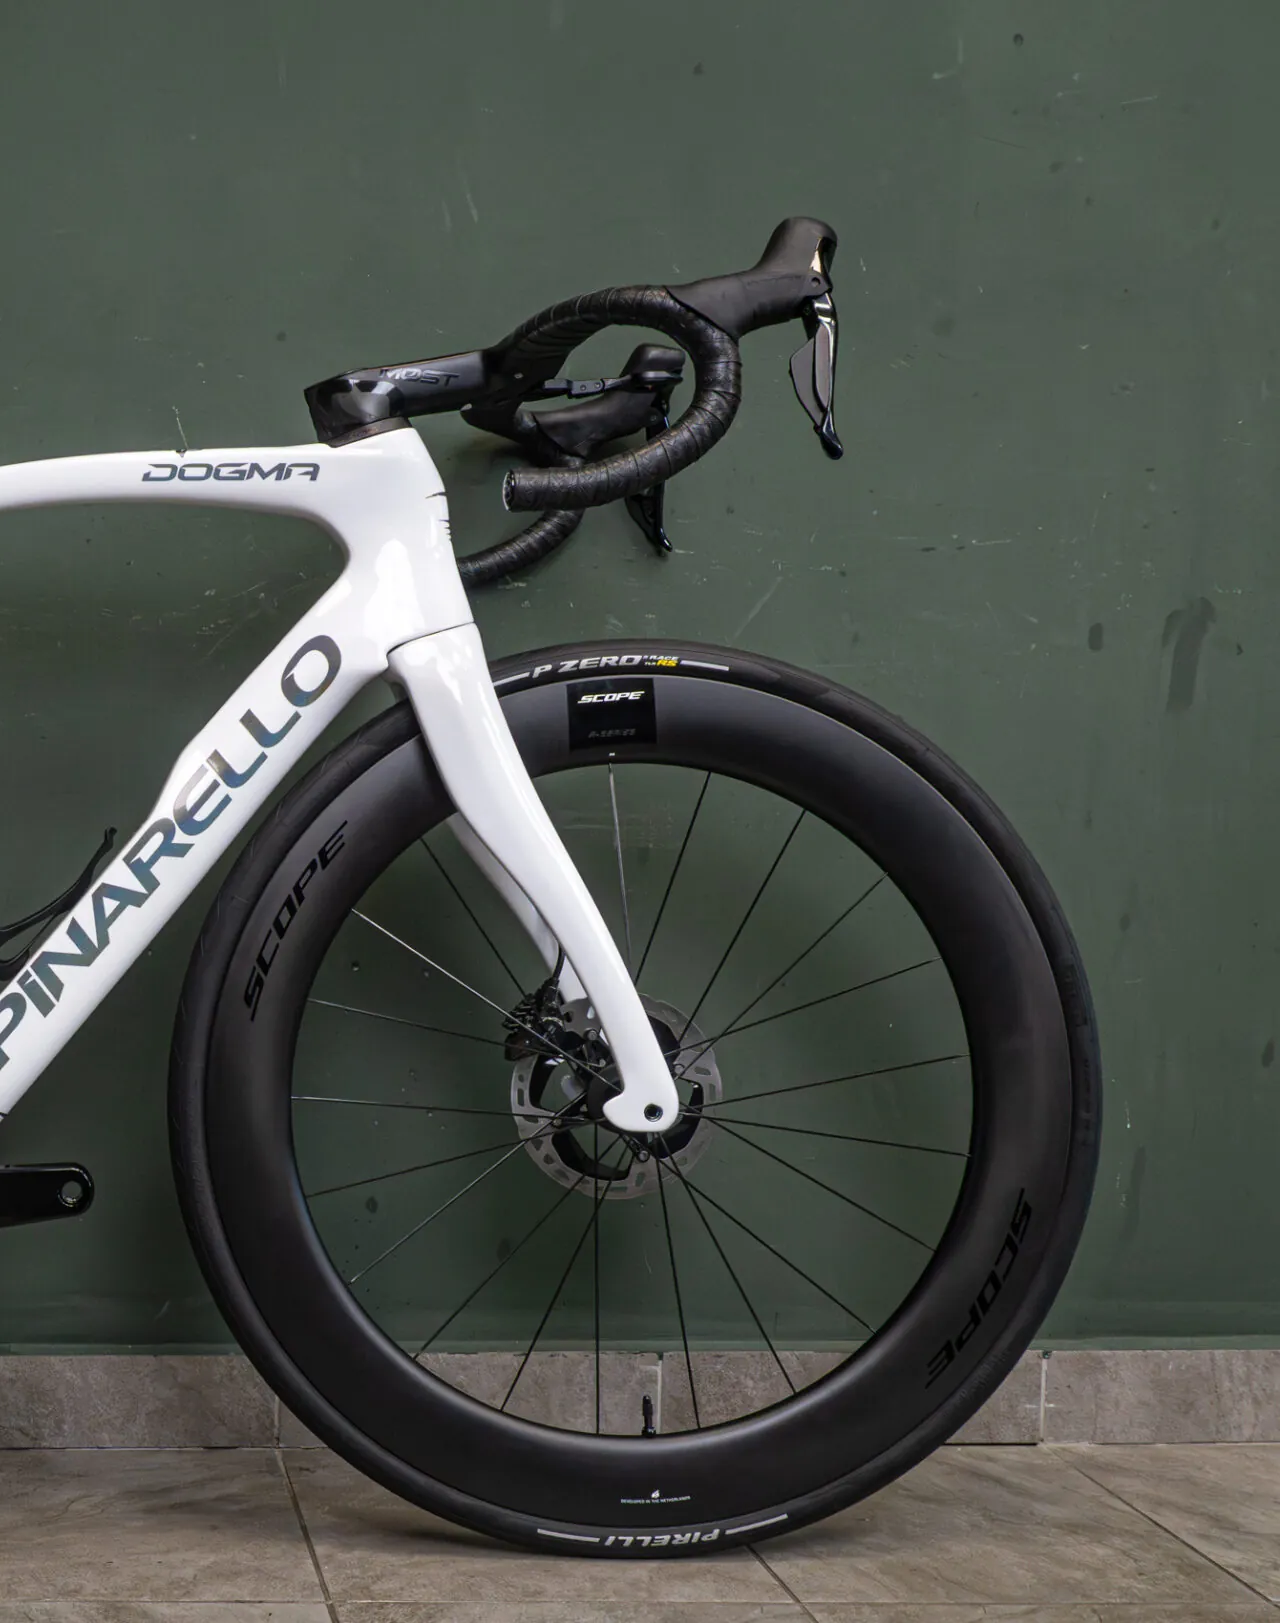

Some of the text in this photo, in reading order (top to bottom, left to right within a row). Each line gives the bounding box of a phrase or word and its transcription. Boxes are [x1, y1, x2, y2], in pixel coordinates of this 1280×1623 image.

[380, 367, 460, 387] MOST
[141, 462, 321, 482] DOGMA
[531, 654, 643, 679] P ZERO
[576, 689, 646, 704] SCOPE
[244, 820, 348, 1022] SCOPE
[924, 1187, 1032, 1389] SCOPE
[604, 1527, 721, 1547] PIRELLI
